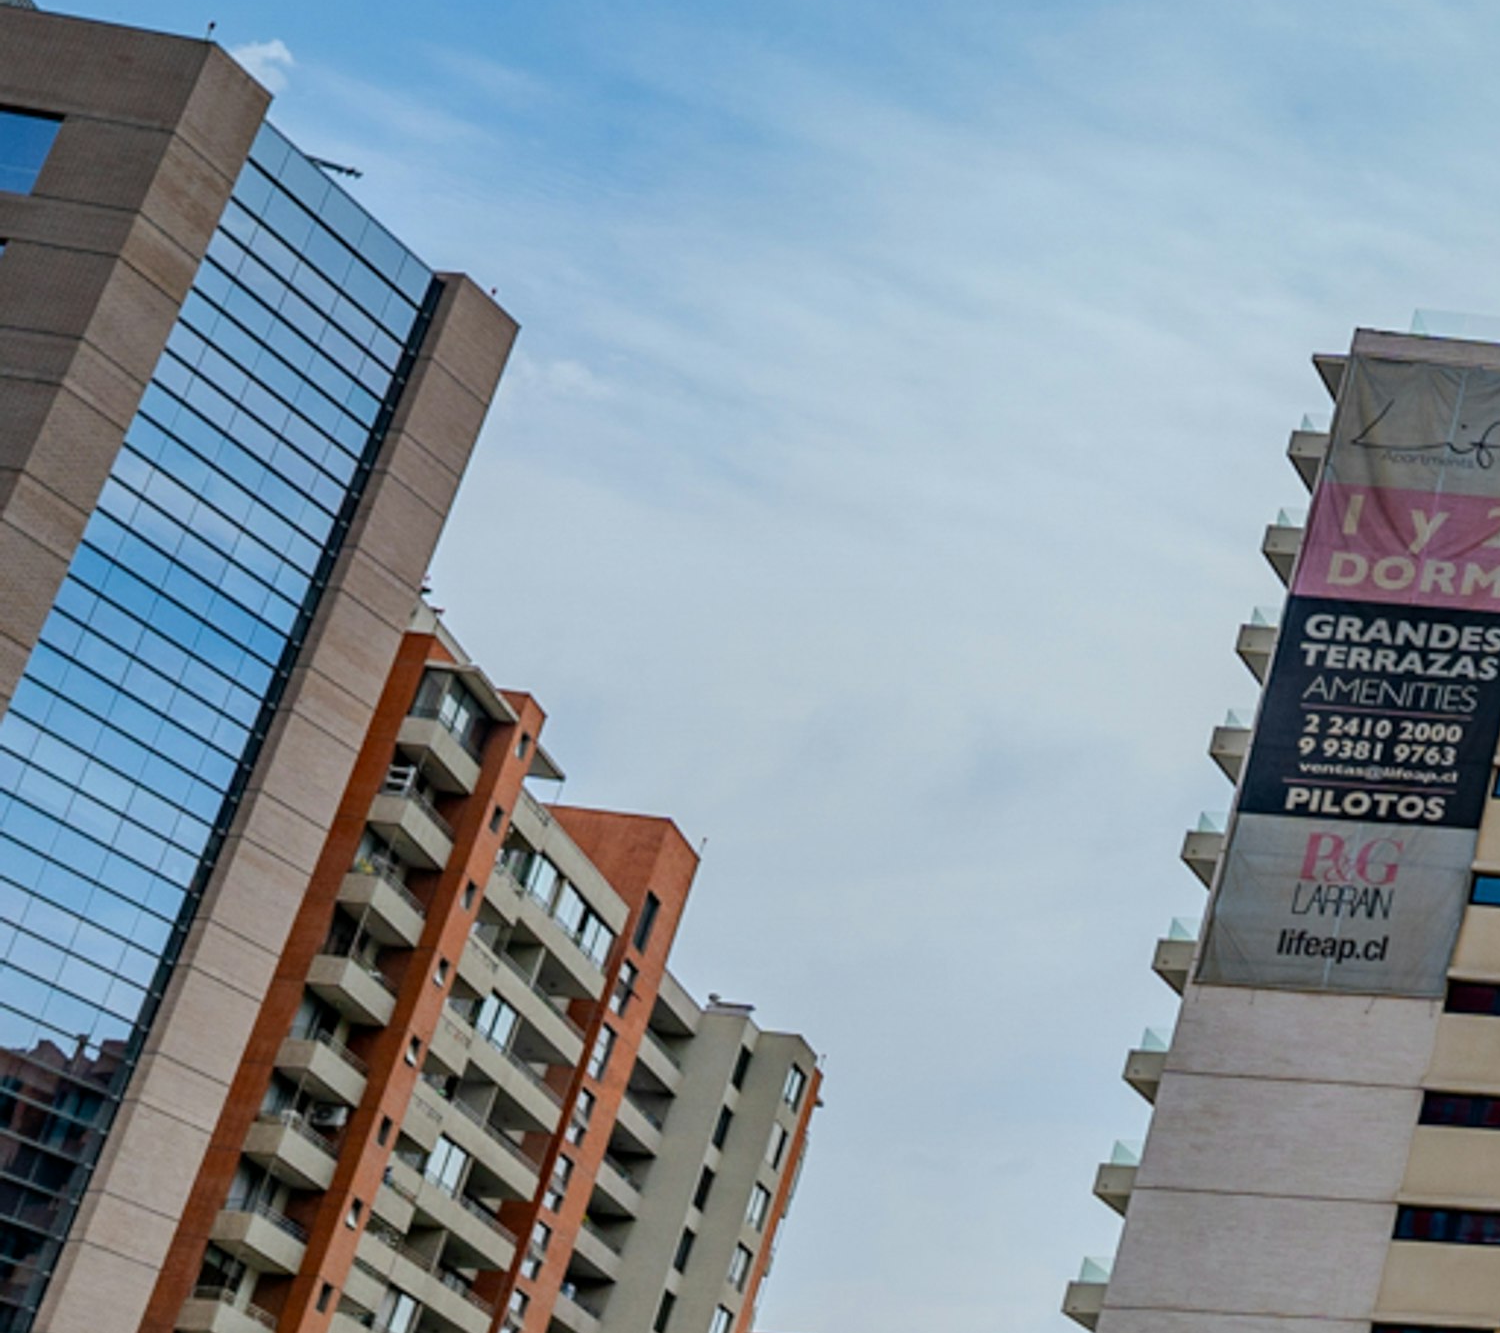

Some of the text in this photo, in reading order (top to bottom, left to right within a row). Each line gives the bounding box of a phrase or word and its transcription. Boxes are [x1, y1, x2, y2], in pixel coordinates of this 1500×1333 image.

[1409, 509, 1449, 555] y
[1301, 643, 1499, 681] TERRAZAS
[1302, 674, 1478, 713] AMENITIES
[1303, 713, 1462, 744] 2 2410 2000
[1298, 736, 1457, 766] 9 9381 9763
[1298, 762, 1459, 784] ventas@lifeap.cl
[1284, 786, 1446, 821] PILOTOS
[1298, 831, 1405, 886] P&G
[1276, 928, 1390, 965] lifeap.cl
